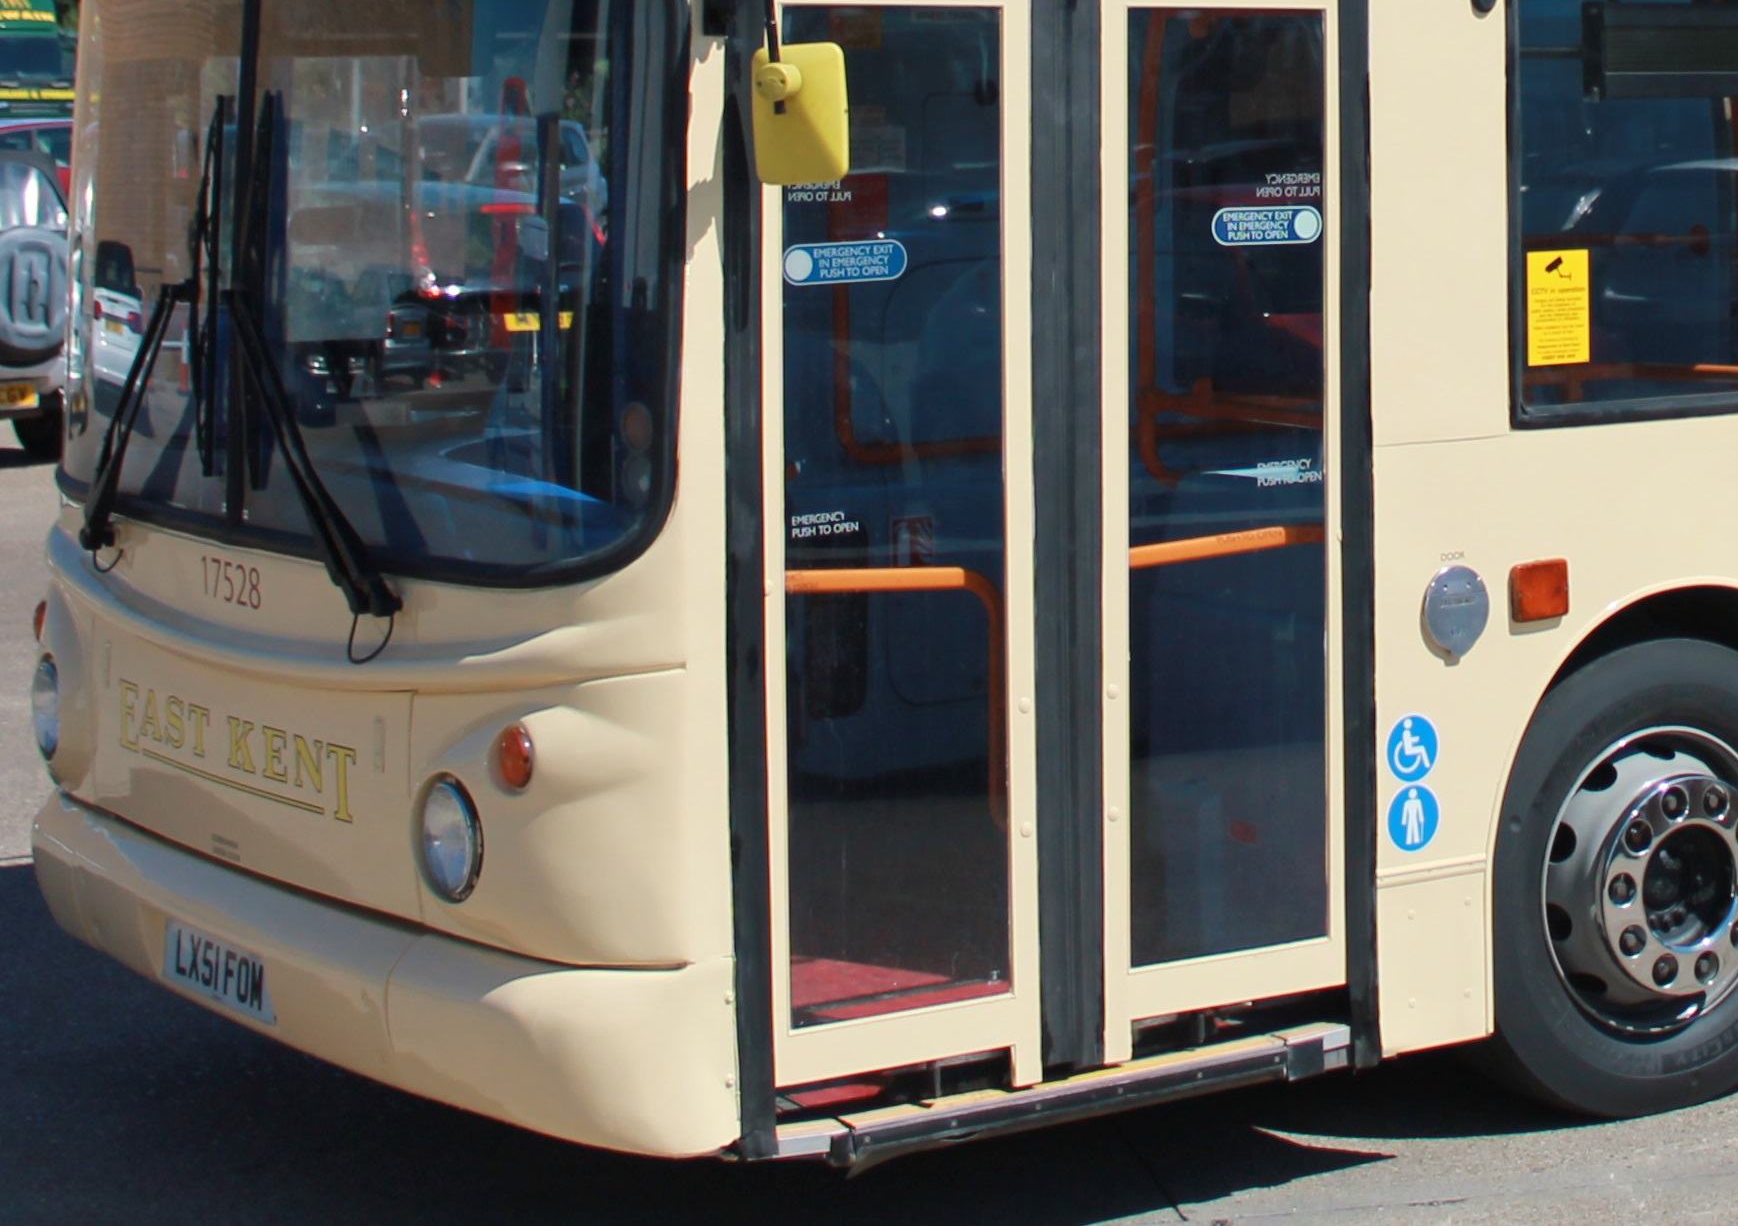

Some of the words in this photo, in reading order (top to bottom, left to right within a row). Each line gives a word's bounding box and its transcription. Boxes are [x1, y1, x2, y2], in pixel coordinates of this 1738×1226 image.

[1223, 211, 1273, 222] EMERGENCY
[1275, 210, 1293, 220] EXIT
[1227, 222, 1238, 231] IN
[1239, 221, 1289, 231] EMERGENCY
[1228, 231, 1250, 241] PUSH
[1251, 230, 1263, 240] TO
[1265, 230, 1288, 239] OPEN
[813, 245, 871, 258] EMERGENCY
[873, 244, 894, 254] EXIT
[819, 258, 830, 268] IN
[832, 255, 890, 268] EMERGENCY
[820, 268, 845, 278] PUSH
[846, 267, 860, 277] TO
[862, 265, 889, 276] OPEN
[791, 511, 845, 526] EMERGENCY
[792, 526, 816, 538] PUSH
[818, 524, 832, 535] TO
[833, 521, 859, 533] OPEN
[202, 554, 262, 610] 17528
[119, 678, 210, 758] EAST
[227, 713, 357, 824] KENT
